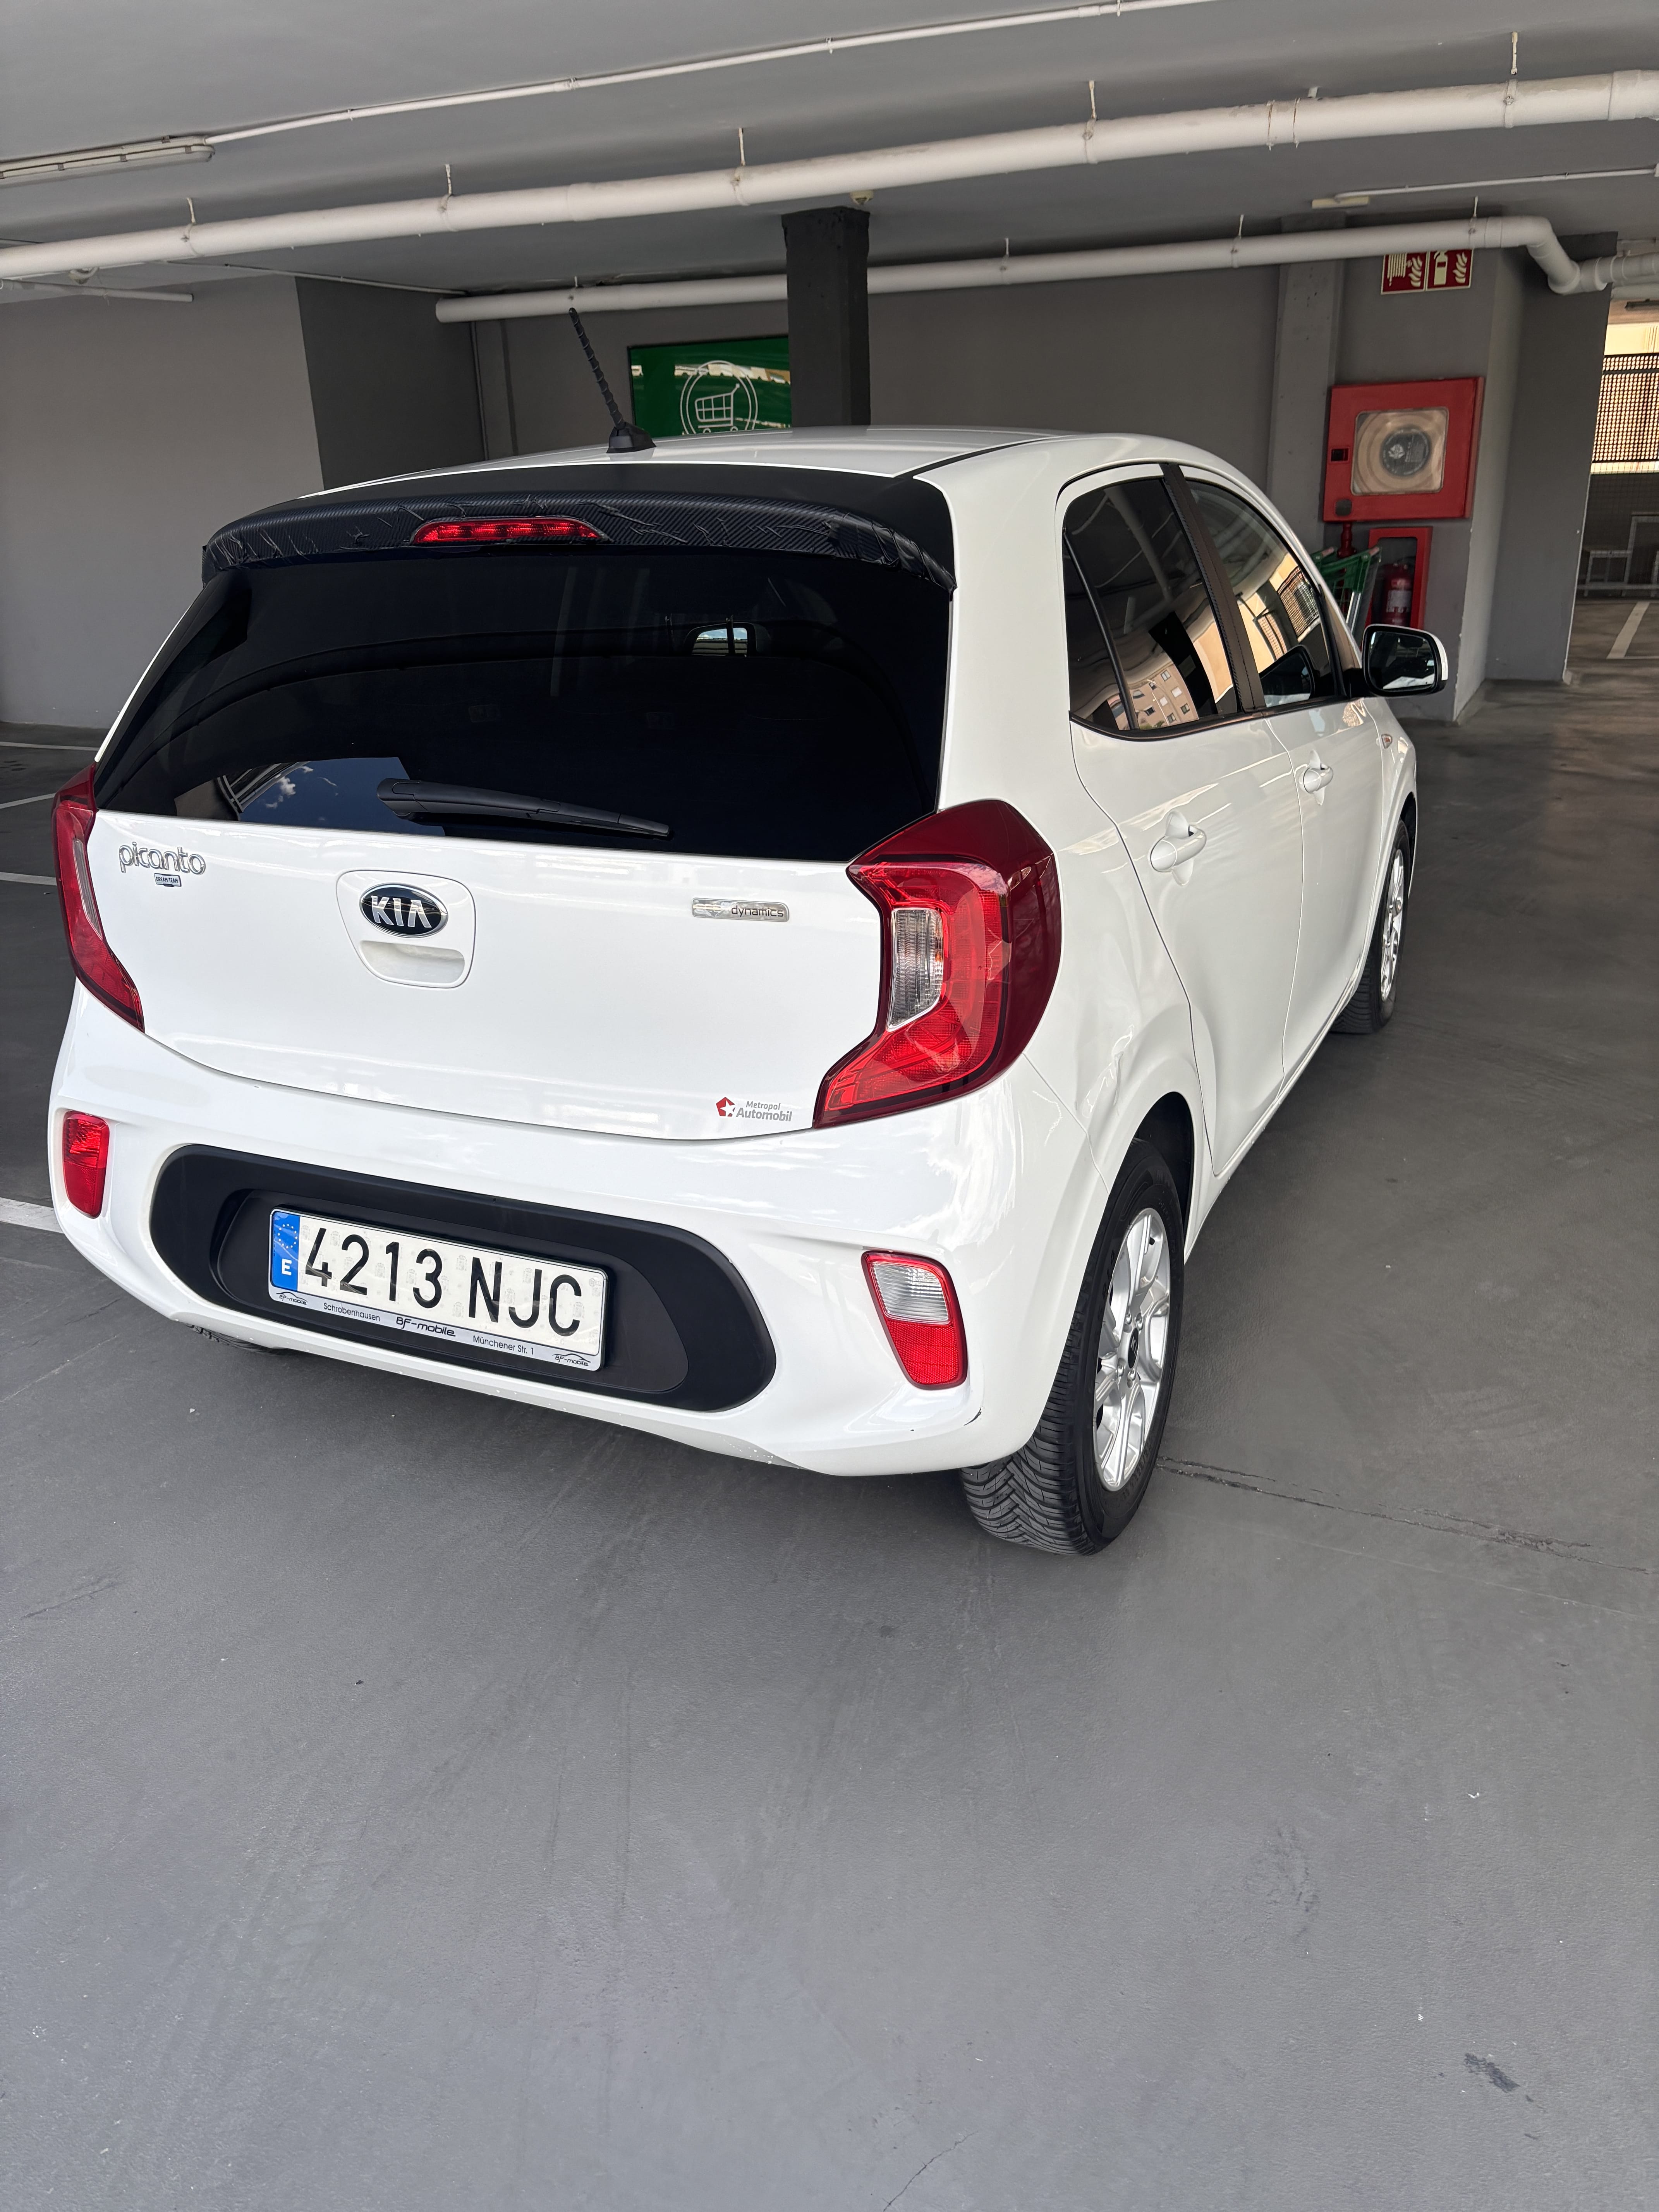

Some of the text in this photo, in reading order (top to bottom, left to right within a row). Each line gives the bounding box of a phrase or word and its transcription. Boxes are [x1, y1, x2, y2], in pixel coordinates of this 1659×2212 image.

[118, 842, 206, 875] picanto
[371, 895, 432, 928] KIA
[732, 905, 784, 917] dynamics
[736, 1108, 792, 1121] Automobil
[746, 1101, 781, 1111] Metropol
[282, 1258, 292, 1276] E
[305, 1228, 582, 1337] 4213 NJC
[323, 1302, 381, 1322] Schrobenhausen
[396, 1316, 456, 1337] BF-mobile
[473, 1335, 515, 1351] Münchener
[517, 1345, 528, 1354] Str.
